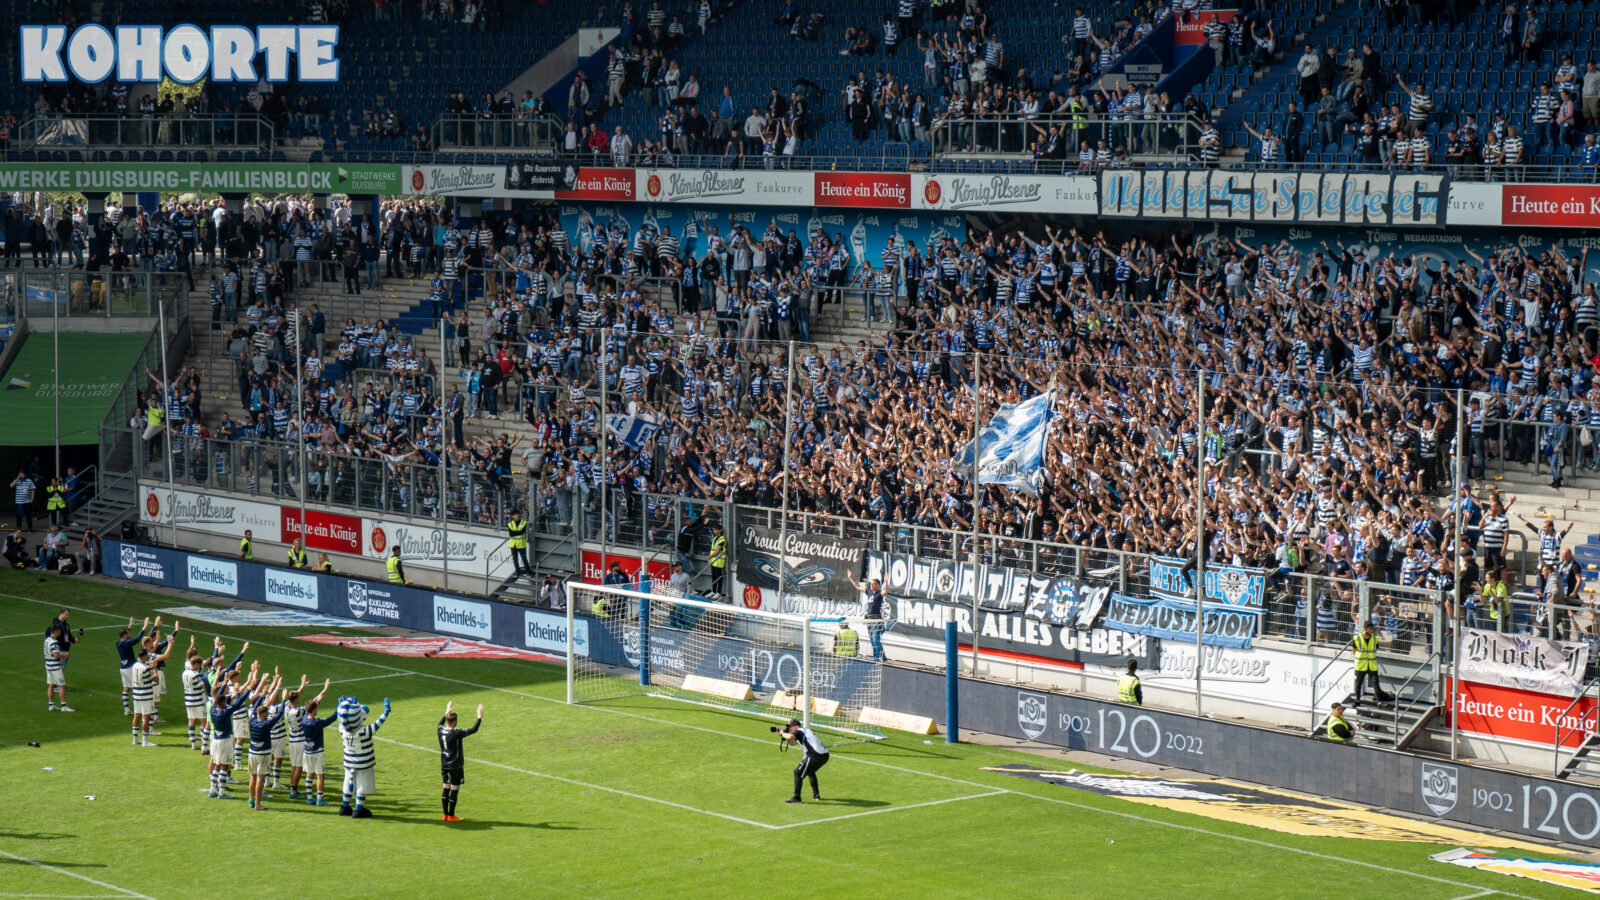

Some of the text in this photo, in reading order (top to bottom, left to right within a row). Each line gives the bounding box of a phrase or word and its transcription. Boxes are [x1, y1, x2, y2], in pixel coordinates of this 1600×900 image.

[352, 172, 397, 181] STADTWERKE
[352, 181, 387, 190] DUISBURG
[588, 177, 601, 190] ein
[604, 177, 632, 197] König
[756, 181, 803, 194] Fankurve
[820, 181, 906, 204] Heute ein König
[1511, 195, 1558, 214] Heute
[1561, 197, 1585, 214] ein
[1404, 234, 1462, 244] WEDAUSTADION
[240, 513, 276, 528] Fankurve
[314, 521, 328, 537] ein
[330, 523, 358, 548] König
[743, 526, 859, 563] Proud Generation
[138, 568, 164, 580] PARTNER
[190, 565, 225, 585] Rheinfels
[267, 578, 305, 599] Rheinfels
[1248, 575, 1266, 607] 47
[368, 599, 398, 611] EXKLUSIV-
[368, 606, 400, 620] PARTNER
[436, 606, 477, 628] Rheinfels
[1109, 598, 1254, 639] WEDAUSTADION
[528, 621, 568, 644] Rheinfel
[981, 613, 1053, 647] ALLES
[1468, 631, 1546, 671] Block
[751, 649, 802, 691] 120
[1160, 648, 1198, 680] önig
[1451, 692, 1597, 743] Heute ein König
[1058, 708, 1204, 758] 1902 120 2022
[1473, 784, 1600, 841] 1902 120
